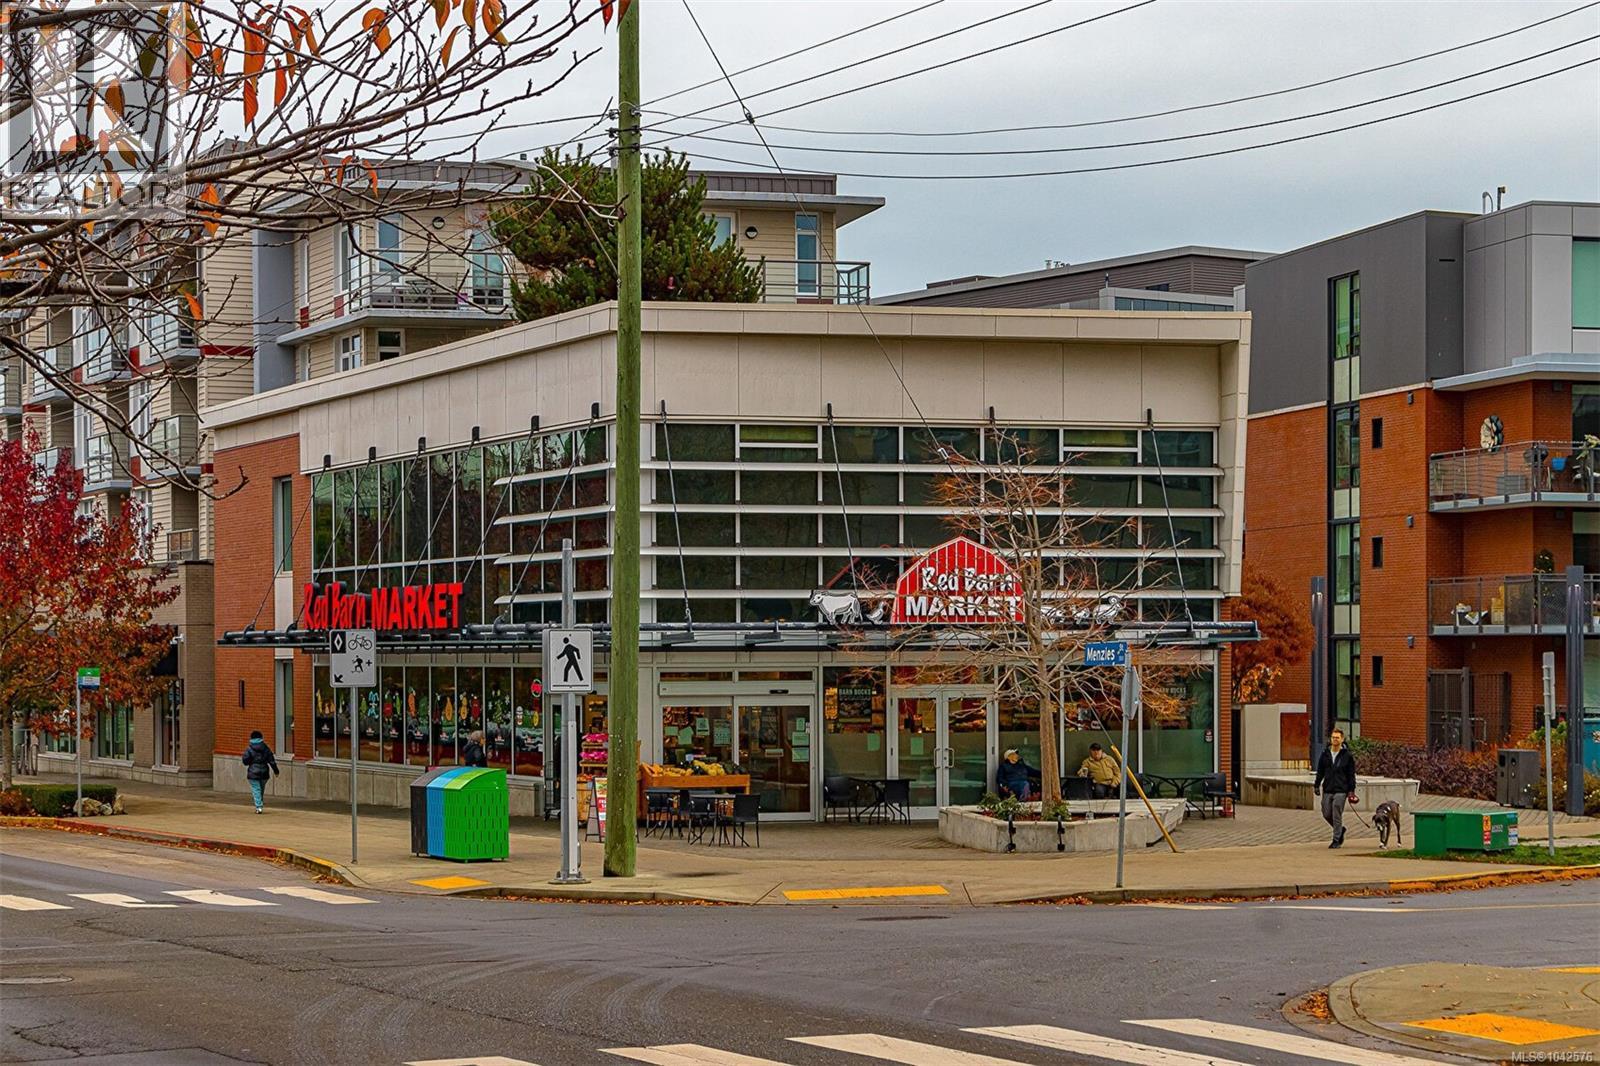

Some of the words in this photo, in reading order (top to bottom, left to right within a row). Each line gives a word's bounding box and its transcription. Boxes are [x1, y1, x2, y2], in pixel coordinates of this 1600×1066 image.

[920, 566, 959, 592] Red
[964, 567, 1013, 592] Barn
[303, 582, 328, 629] Red
[331, 581, 366, 629] Barn
[371, 582, 464, 630] MARKET
[905, 595, 1021, 617] MARKET
[1086, 647, 1115, 661] Menzies
